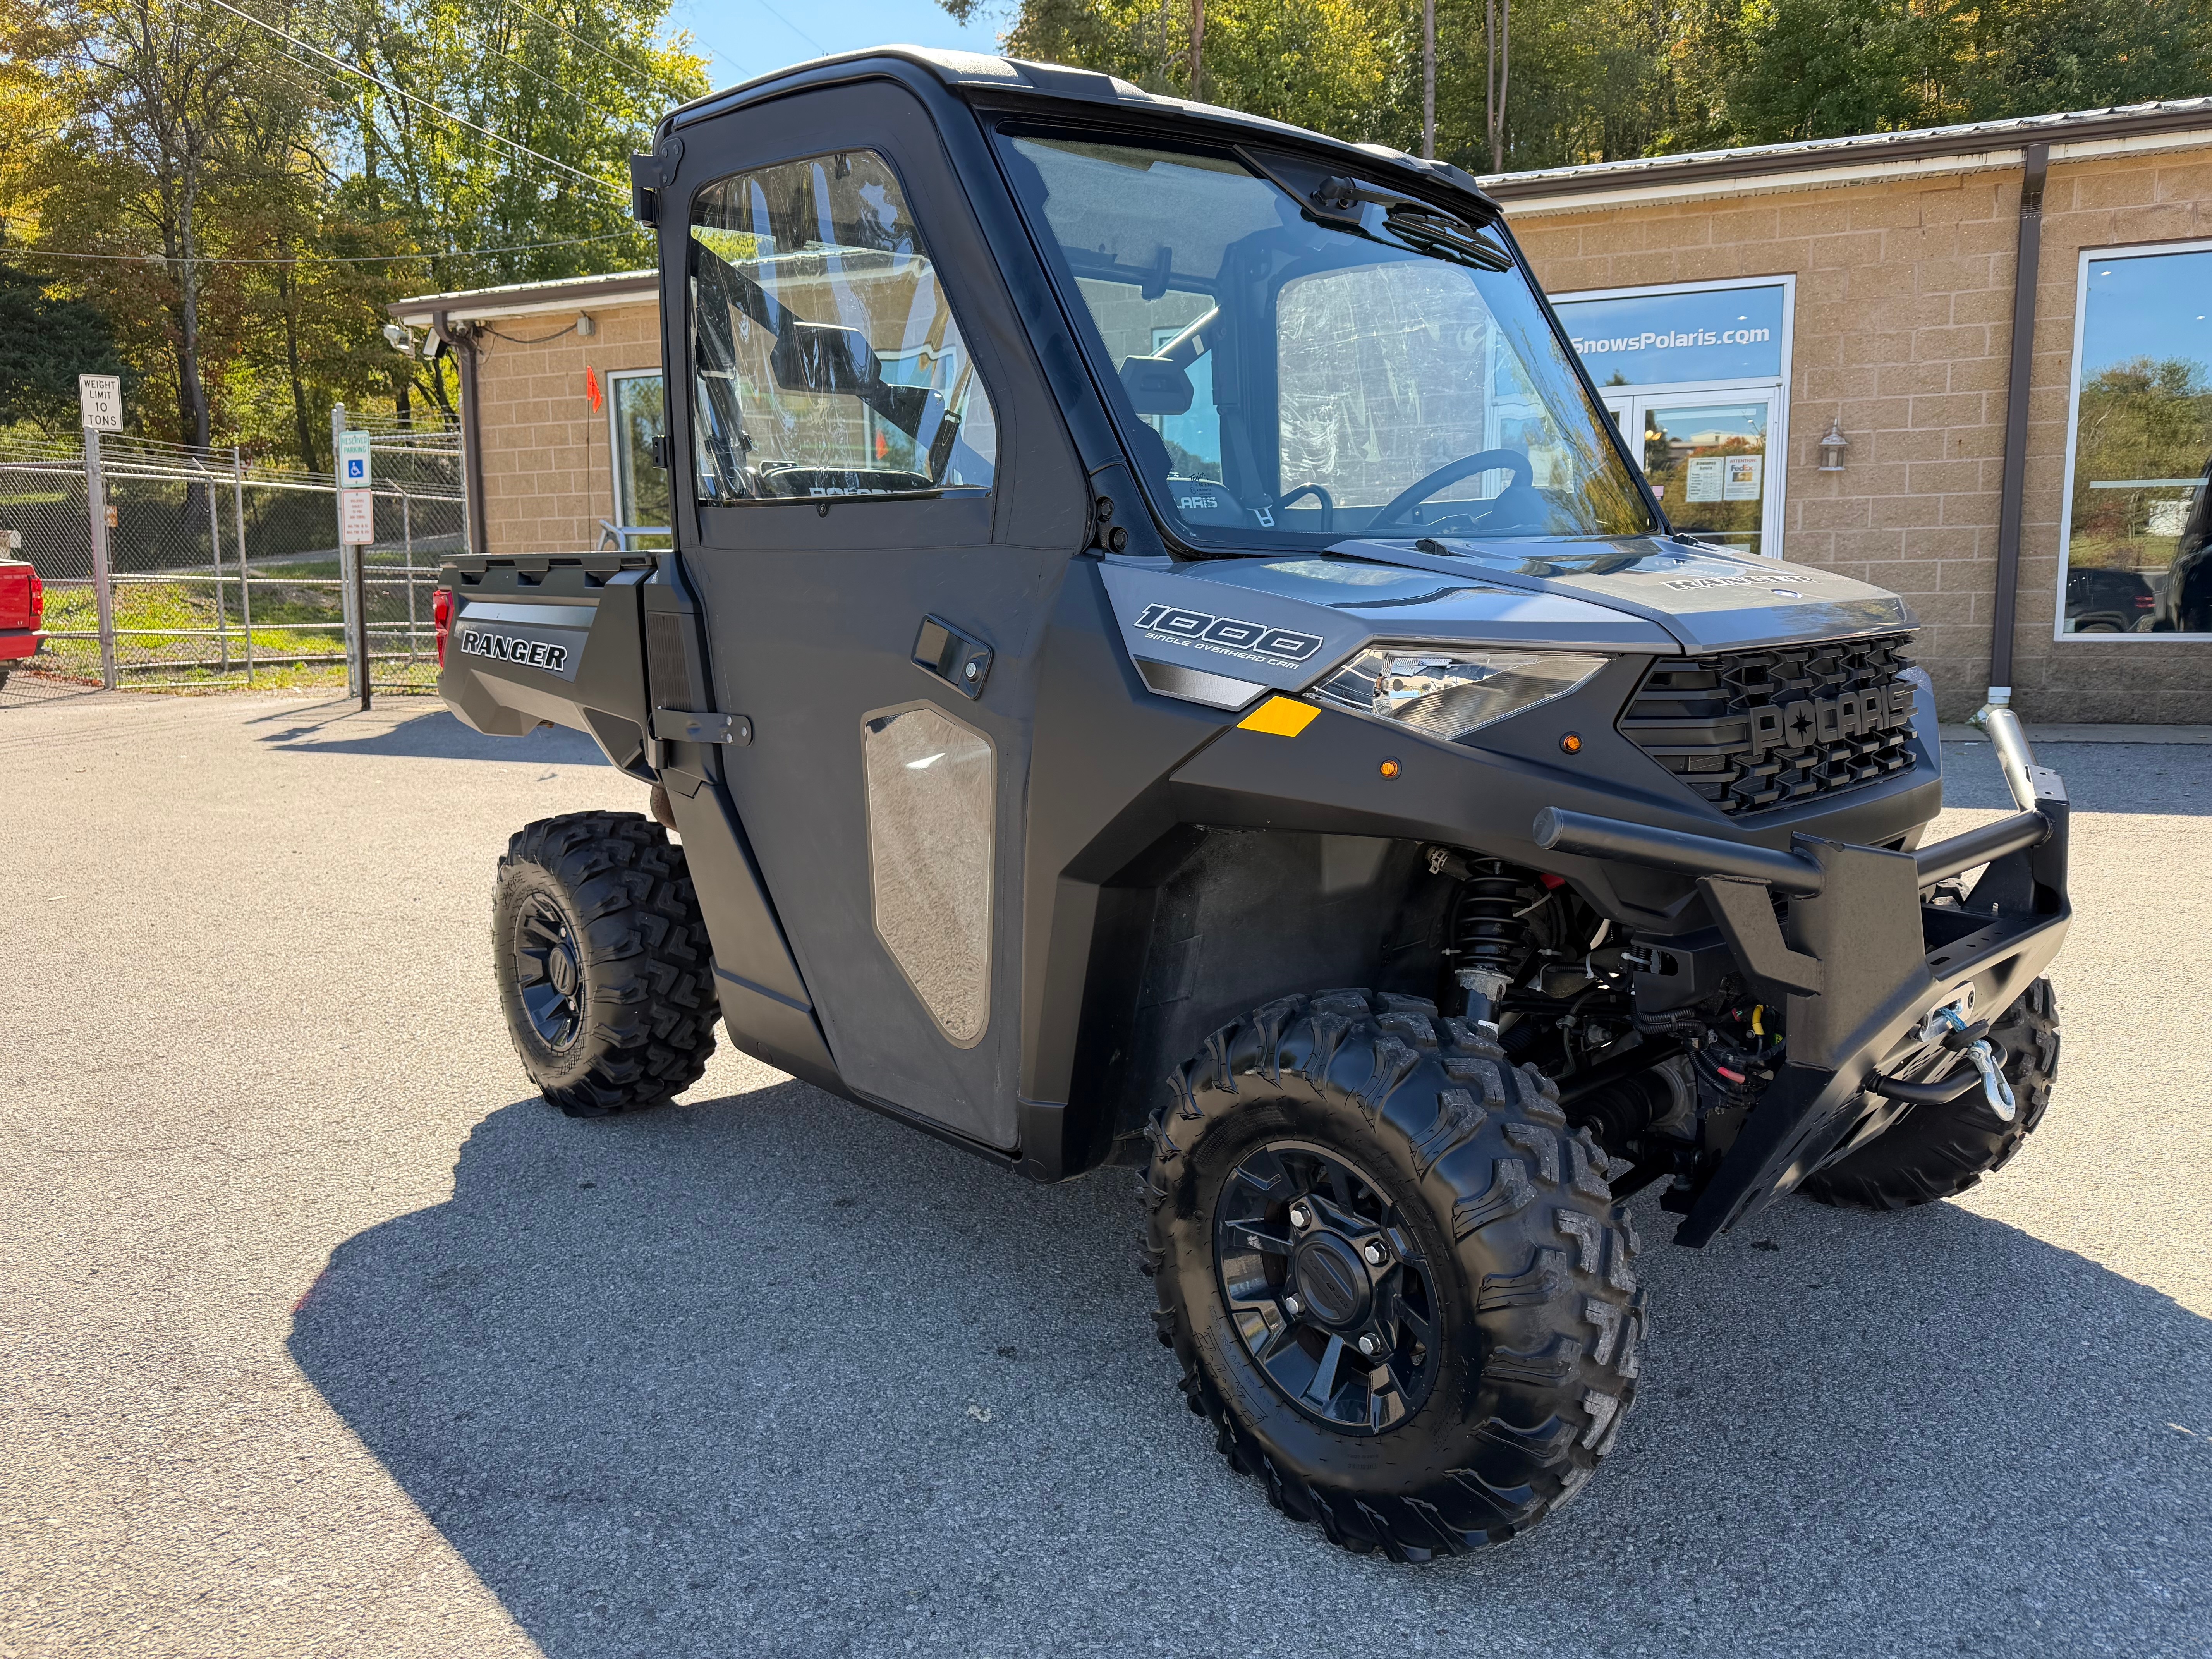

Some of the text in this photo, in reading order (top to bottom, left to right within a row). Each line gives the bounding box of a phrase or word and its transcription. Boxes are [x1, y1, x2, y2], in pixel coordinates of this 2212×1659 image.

[1571, 328, 1769, 354] SnowsPolaris.com
[84, 380, 115, 389] WEIGHT
[89, 390, 111, 399] LIMIT
[95, 402, 107, 412] 10
[88, 414, 117, 426] TONS
[342, 437, 367, 445] RESERVED
[1188, 472, 1206, 483] Taylor
[1178, 497, 1218, 509] ARIS
[1659, 575, 1820, 591] RANGER
[1133, 603, 1324, 660] 1000
[461, 630, 567, 672] RANGER
[1145, 632, 1300, 670] SINGLE OVERHEAD CAM
[1749, 682, 1910, 756] POLARIS
[1208, 1305, 1221, 1330] ONLY
[1220, 1333, 1231, 1352] USE
[1230, 1355, 1244, 1374] UTV
[1245, 1375, 1255, 1388] OR
